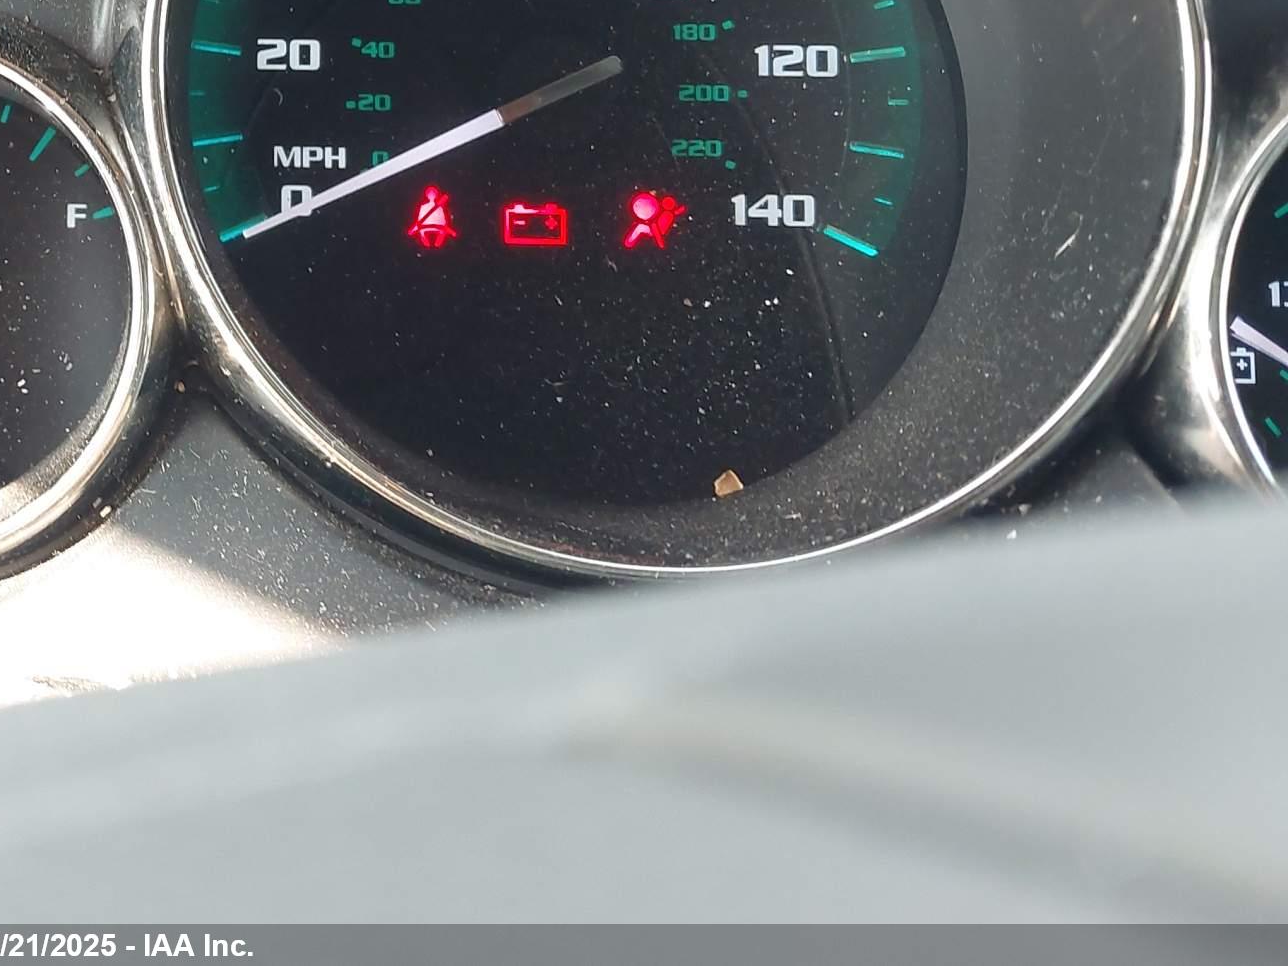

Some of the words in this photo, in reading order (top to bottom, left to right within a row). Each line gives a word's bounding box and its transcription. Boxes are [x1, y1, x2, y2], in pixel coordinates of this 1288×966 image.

[672, 24, 716, 42] 180
[255, 38, 322, 72] 20
[360, 40, 396, 59] 40
[753, 44, 840, 78] 120
[357, 93, 392, 112] 20
[677, 83, 730, 103] 200
[273, 145, 346, 169] MPH
[671, 139, 723, 158] 220
[281, 184, 312, 216] 0
[731, 194, 816, 228] 140
[66, 203, 88, 228] F
[1268, 281, 1288, 307] 1
